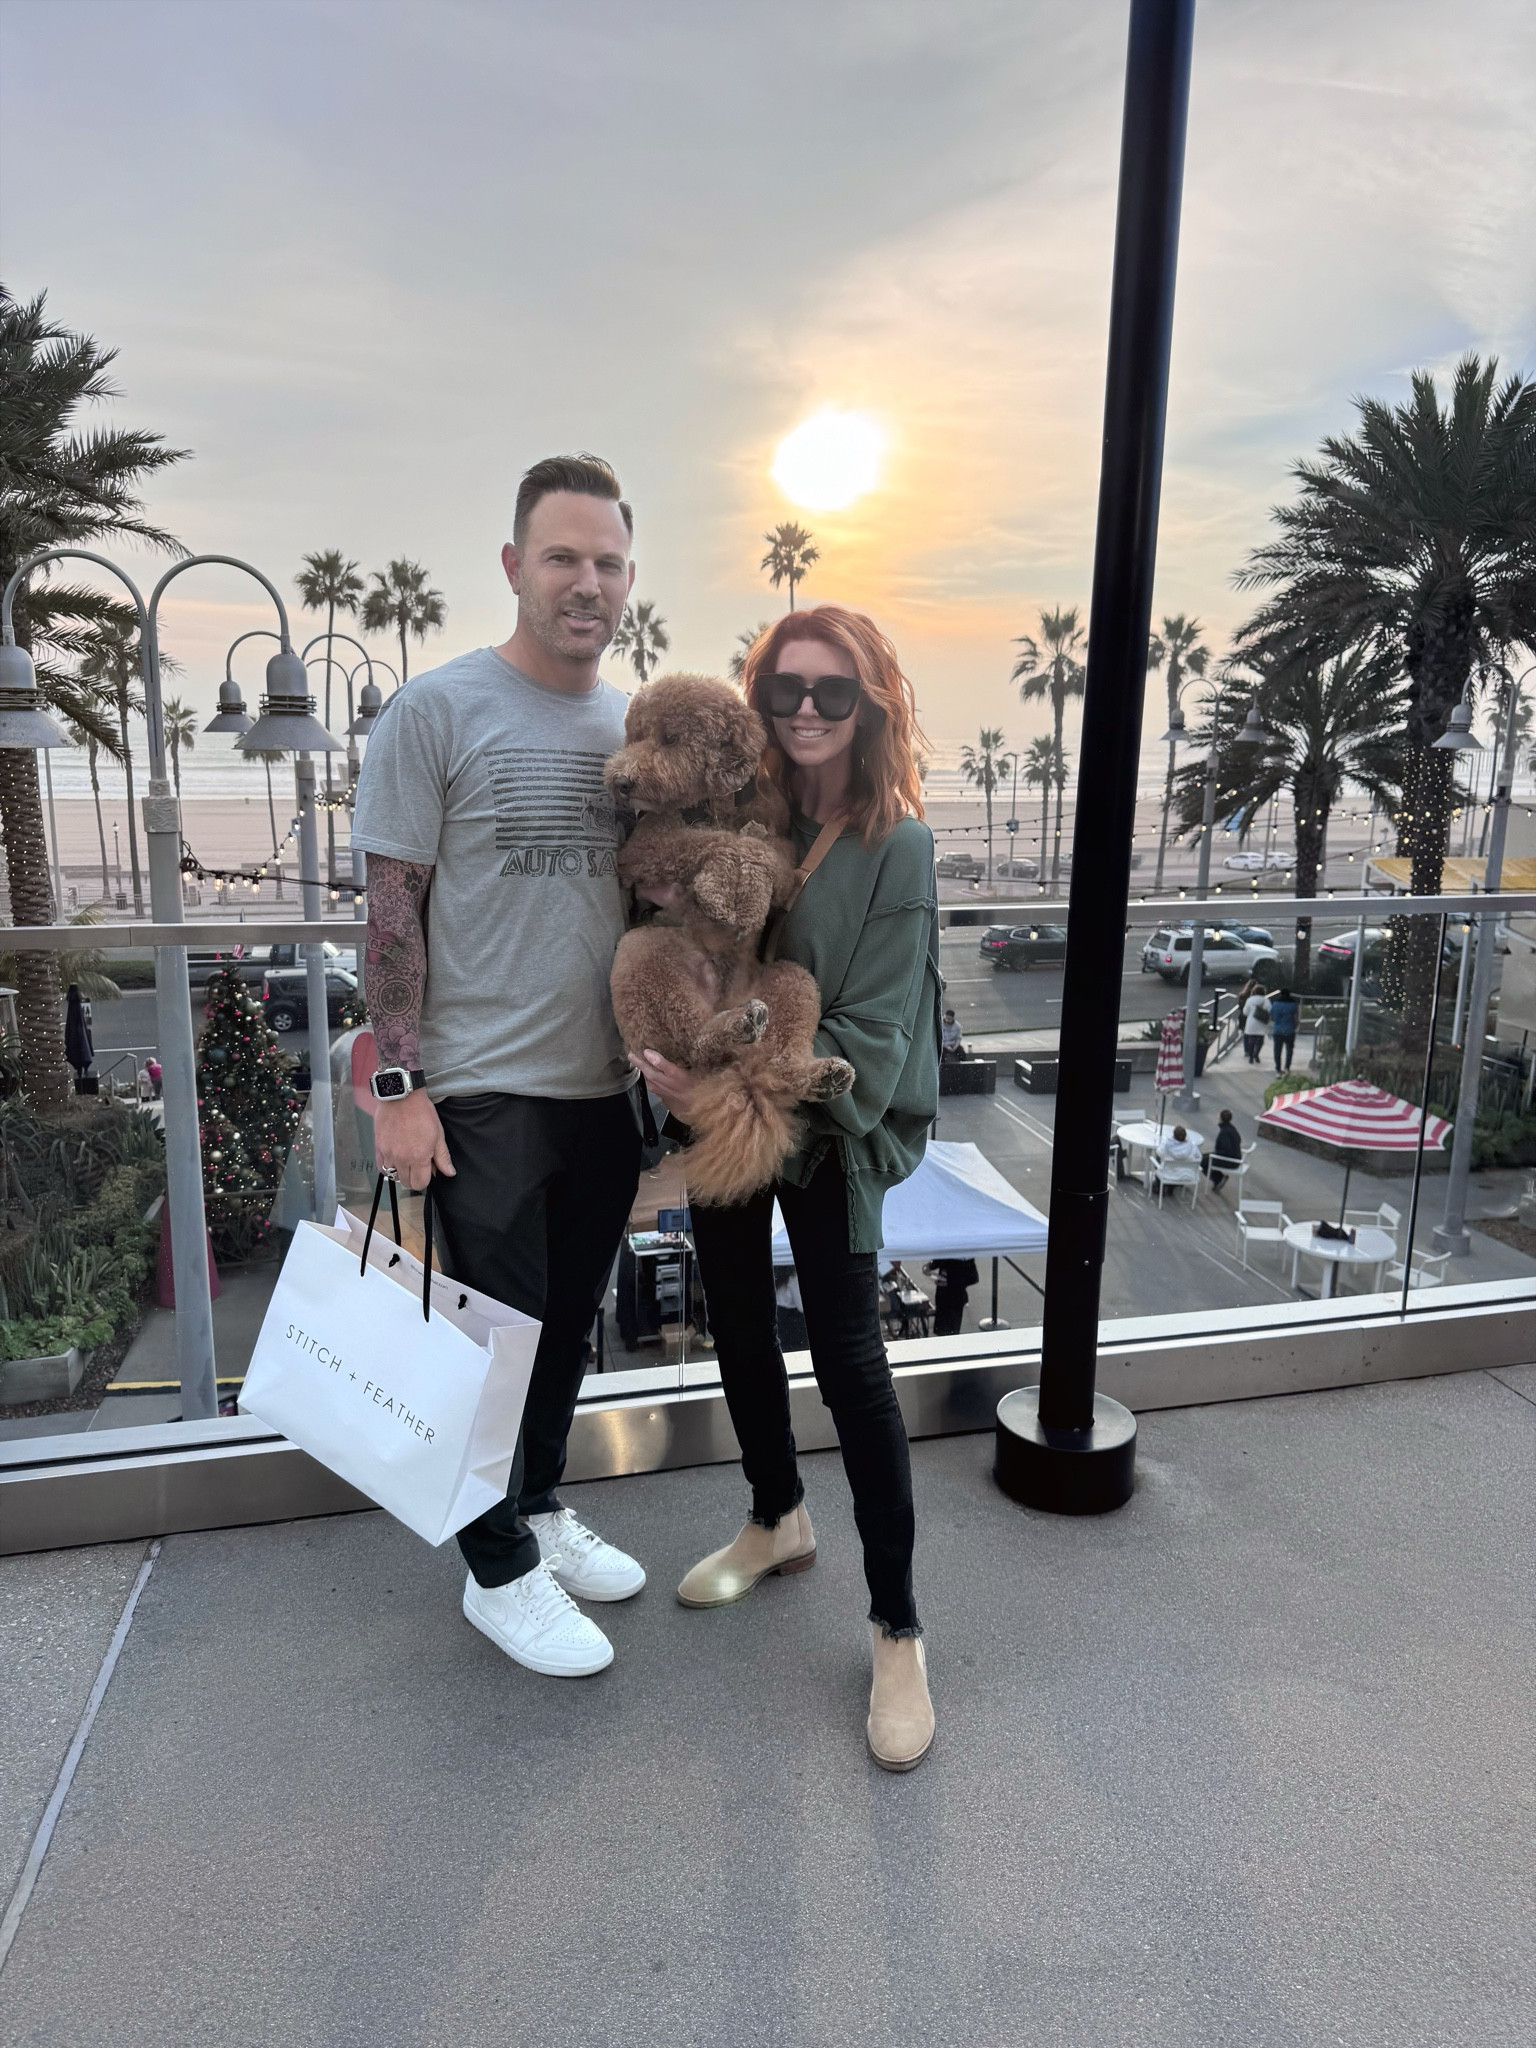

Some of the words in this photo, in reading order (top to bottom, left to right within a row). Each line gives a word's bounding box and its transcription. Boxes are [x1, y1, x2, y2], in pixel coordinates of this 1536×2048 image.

[587, 849, 618, 877] SA
[286, 1324, 342, 1372] STITCH
[363, 1381, 435, 1444] FEATHER
